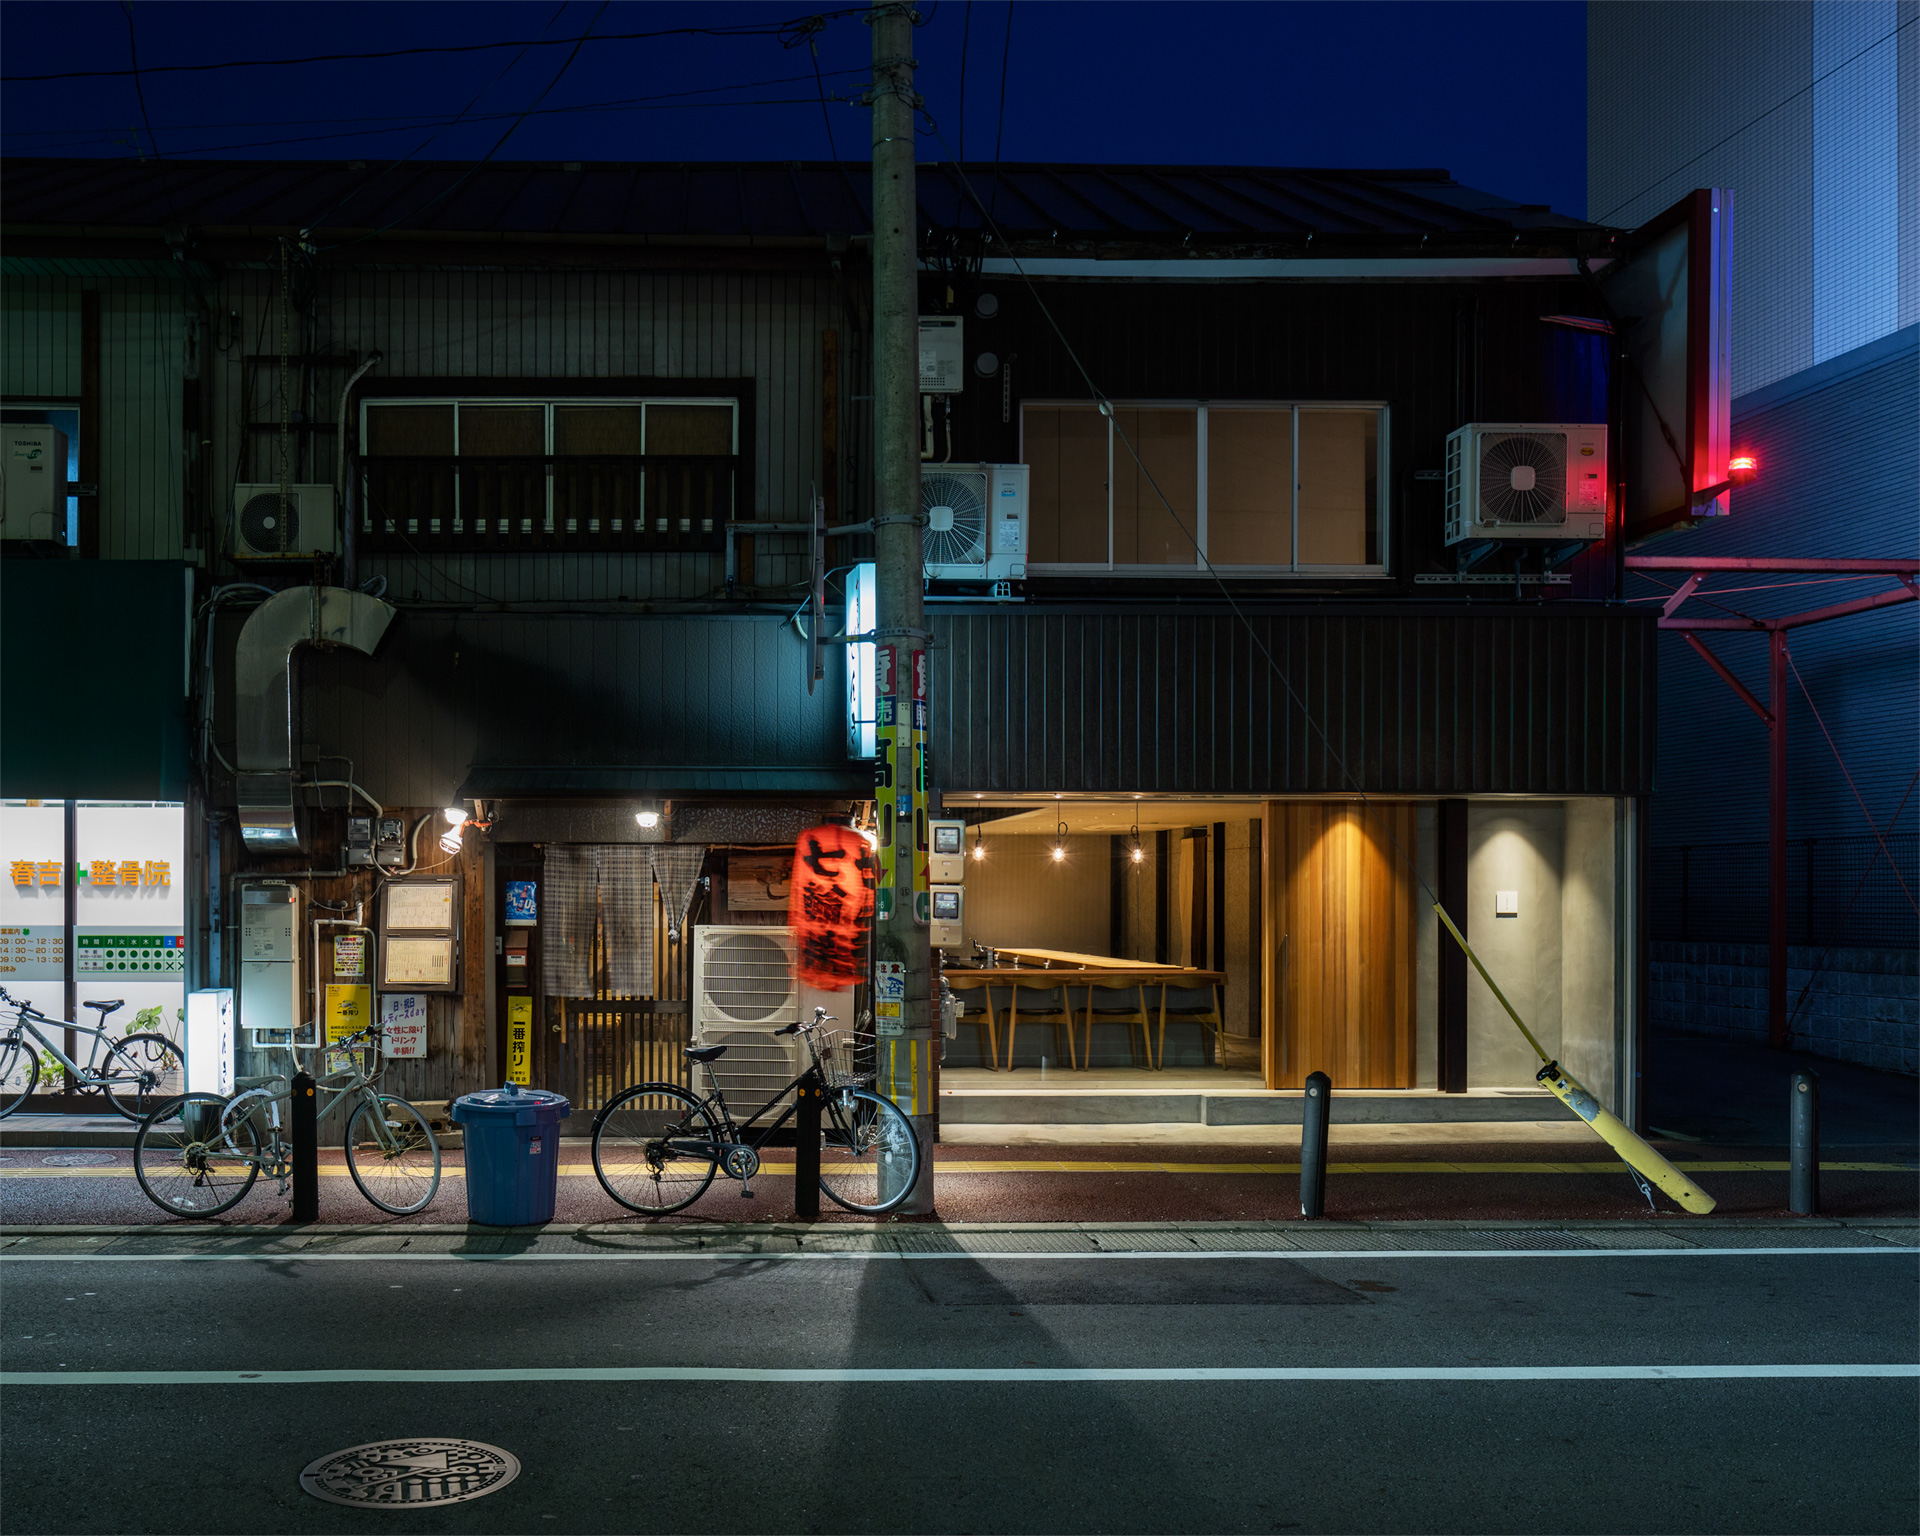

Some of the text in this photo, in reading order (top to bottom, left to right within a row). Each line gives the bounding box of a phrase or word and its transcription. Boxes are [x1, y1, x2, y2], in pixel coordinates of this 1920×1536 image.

[10, 859, 171, 886] 春吉 整骨院
[386, 1025, 423, 1035] 女性に限り
[391, 1036, 417, 1045] ドリンク
[512, 1020, 527, 1067] 一番搾り
